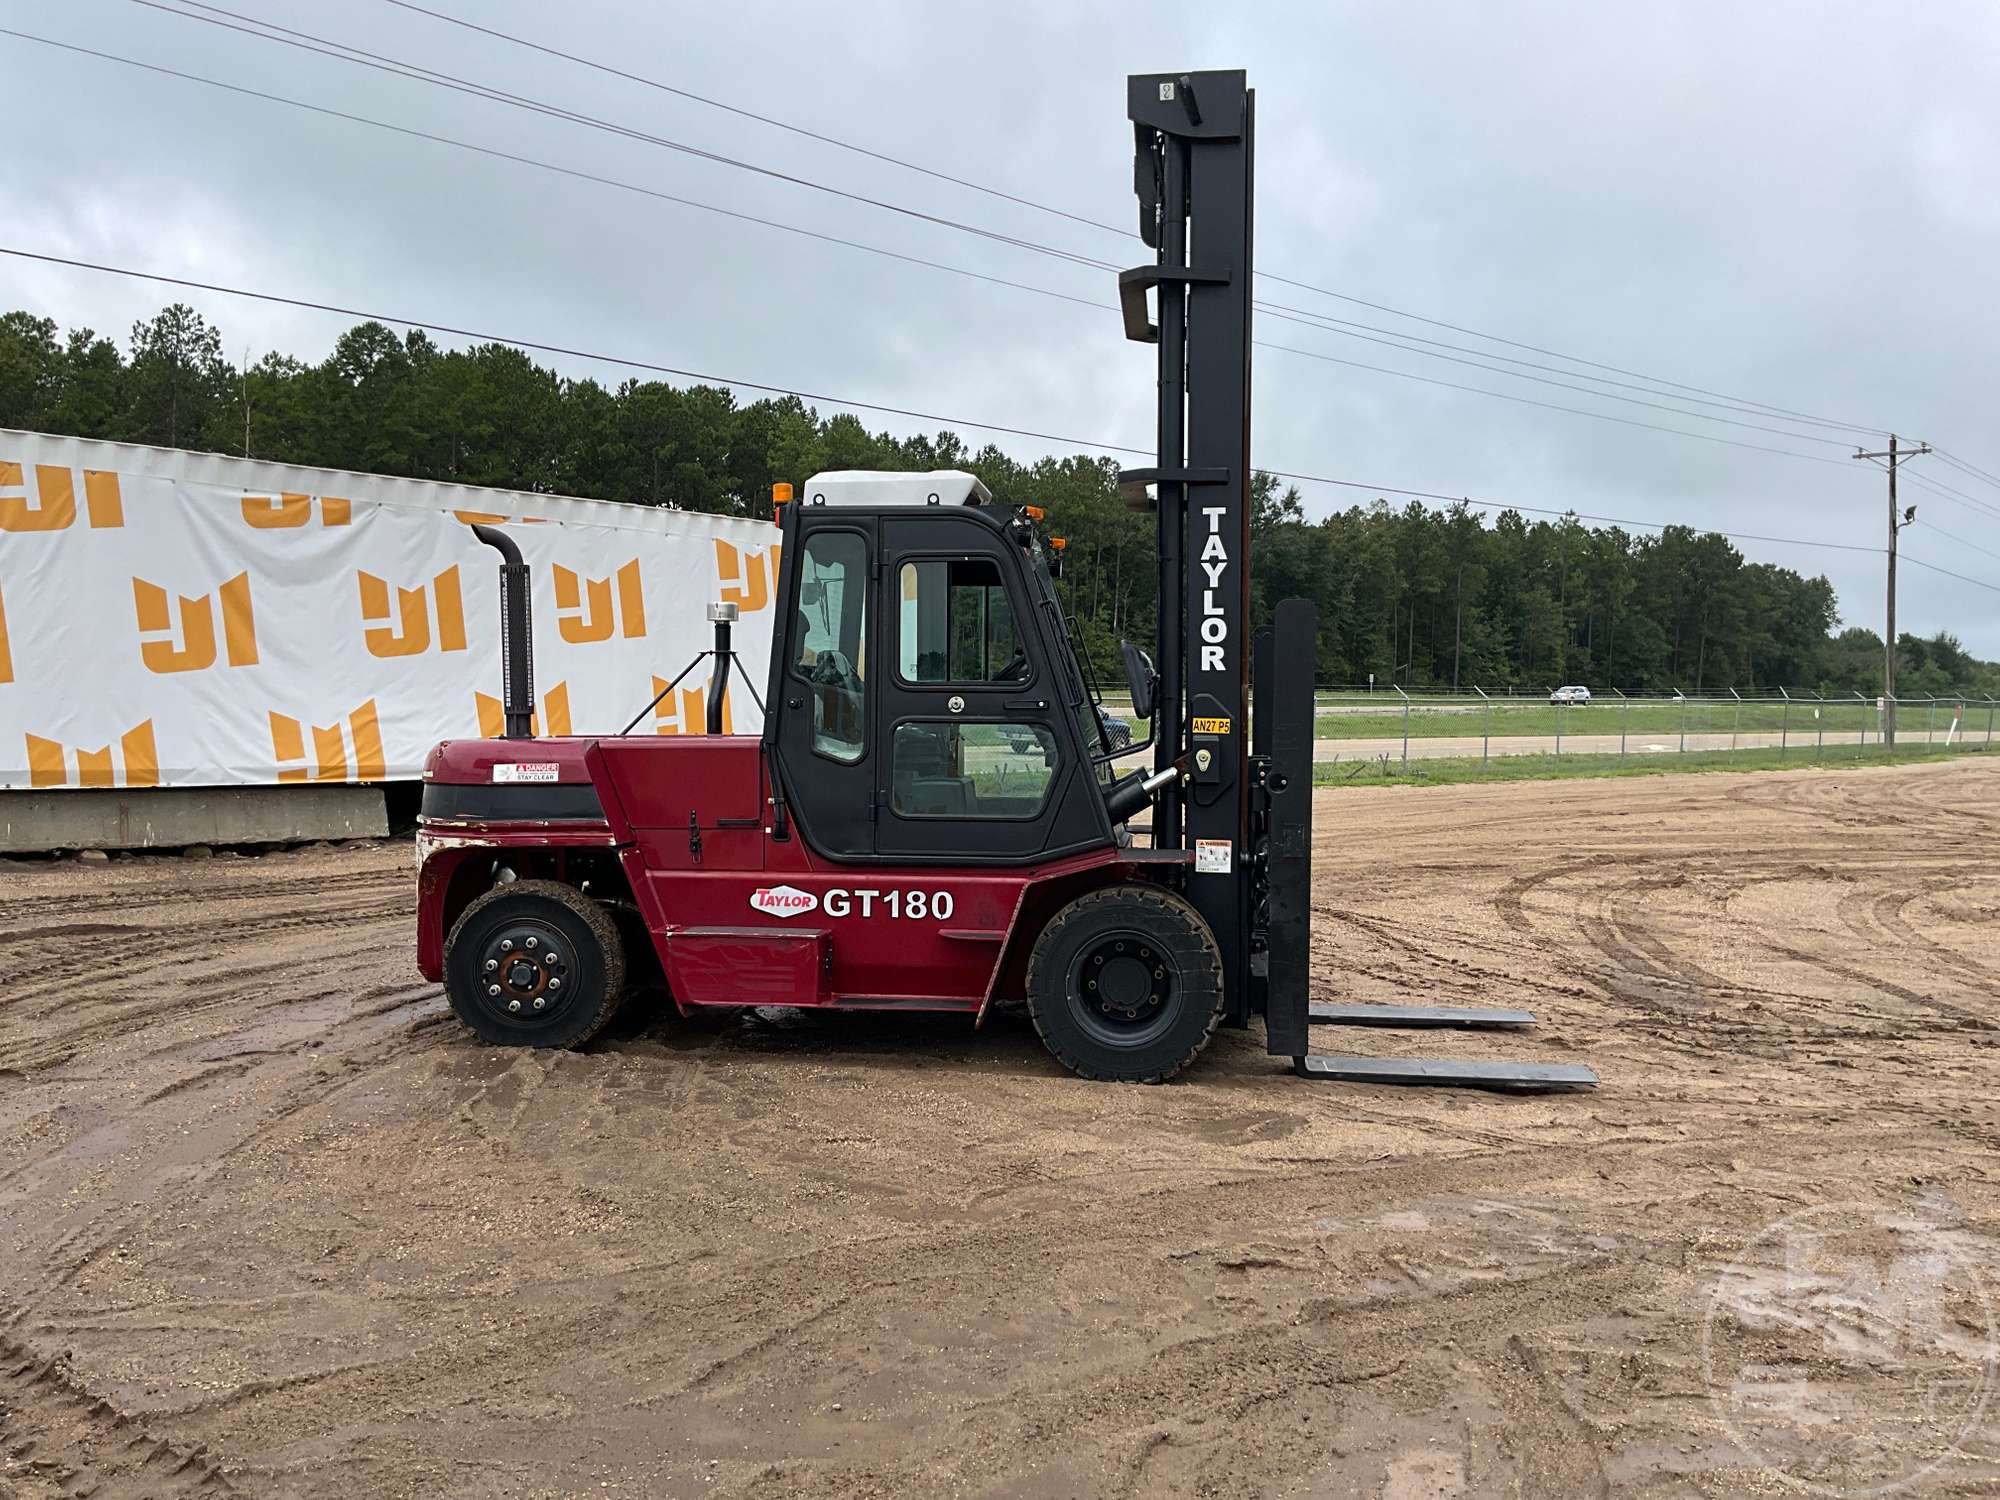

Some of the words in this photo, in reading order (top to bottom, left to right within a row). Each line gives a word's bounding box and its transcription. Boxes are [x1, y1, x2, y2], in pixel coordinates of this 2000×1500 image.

[1200, 507, 1228, 671] TAYLOR
[1193, 719, 1217, 732] AN27
[1218, 720, 1230, 733] P5
[525, 763, 558, 772] DANGER
[756, 888, 811, 908] TAYLOR
[823, 888, 954, 920] GT180
